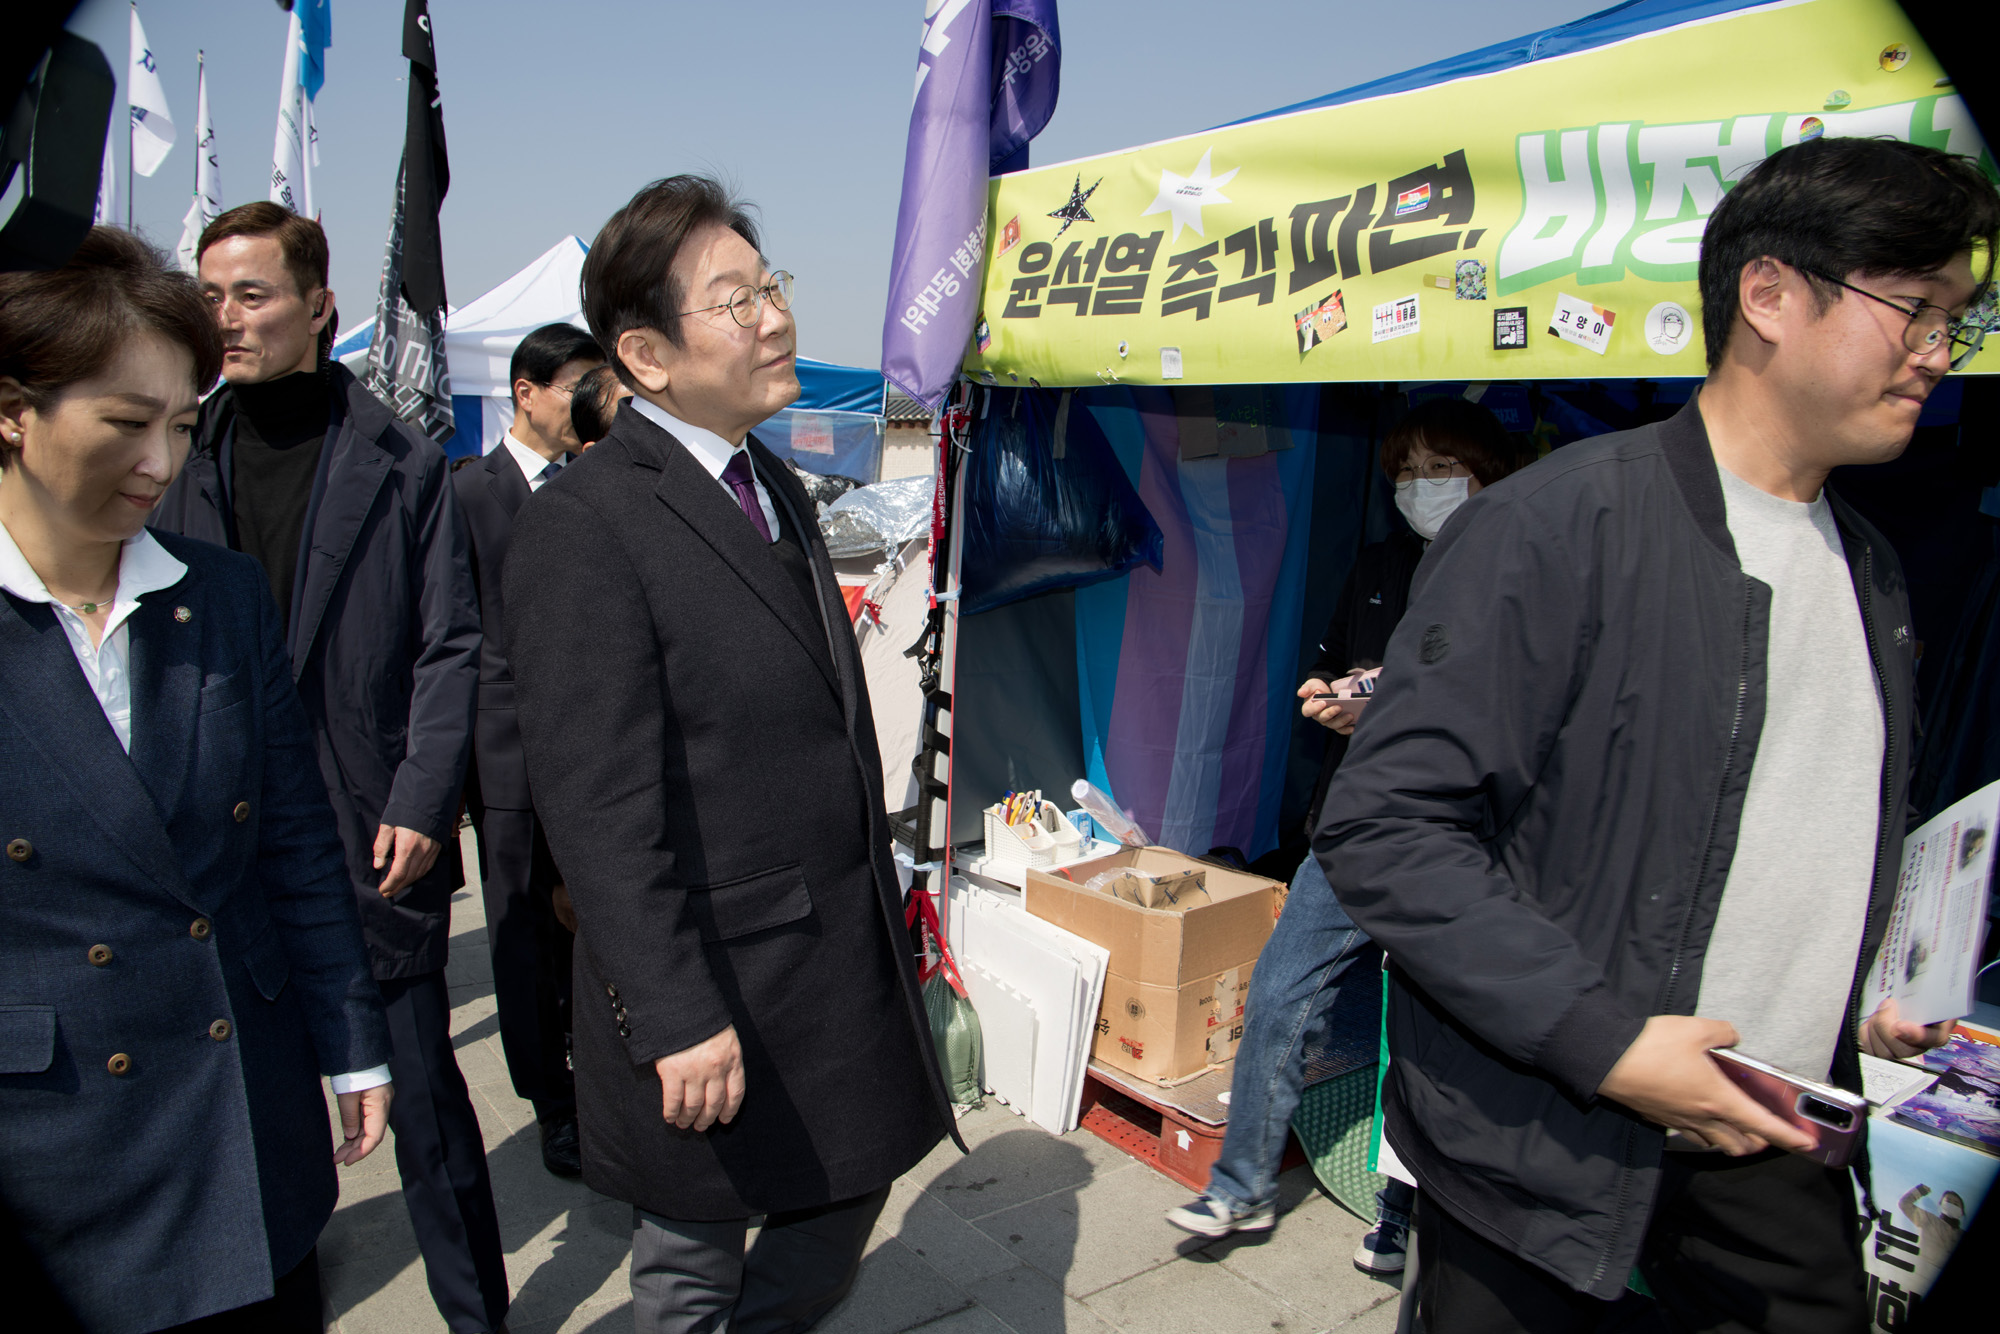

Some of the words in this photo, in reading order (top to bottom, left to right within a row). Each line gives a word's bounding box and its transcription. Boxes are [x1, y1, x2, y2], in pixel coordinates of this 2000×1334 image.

[1002, 230, 1163, 319] 윤석열
[1161, 217, 1279, 321] 즉각
[1558, 309, 1606, 337] 고양이
